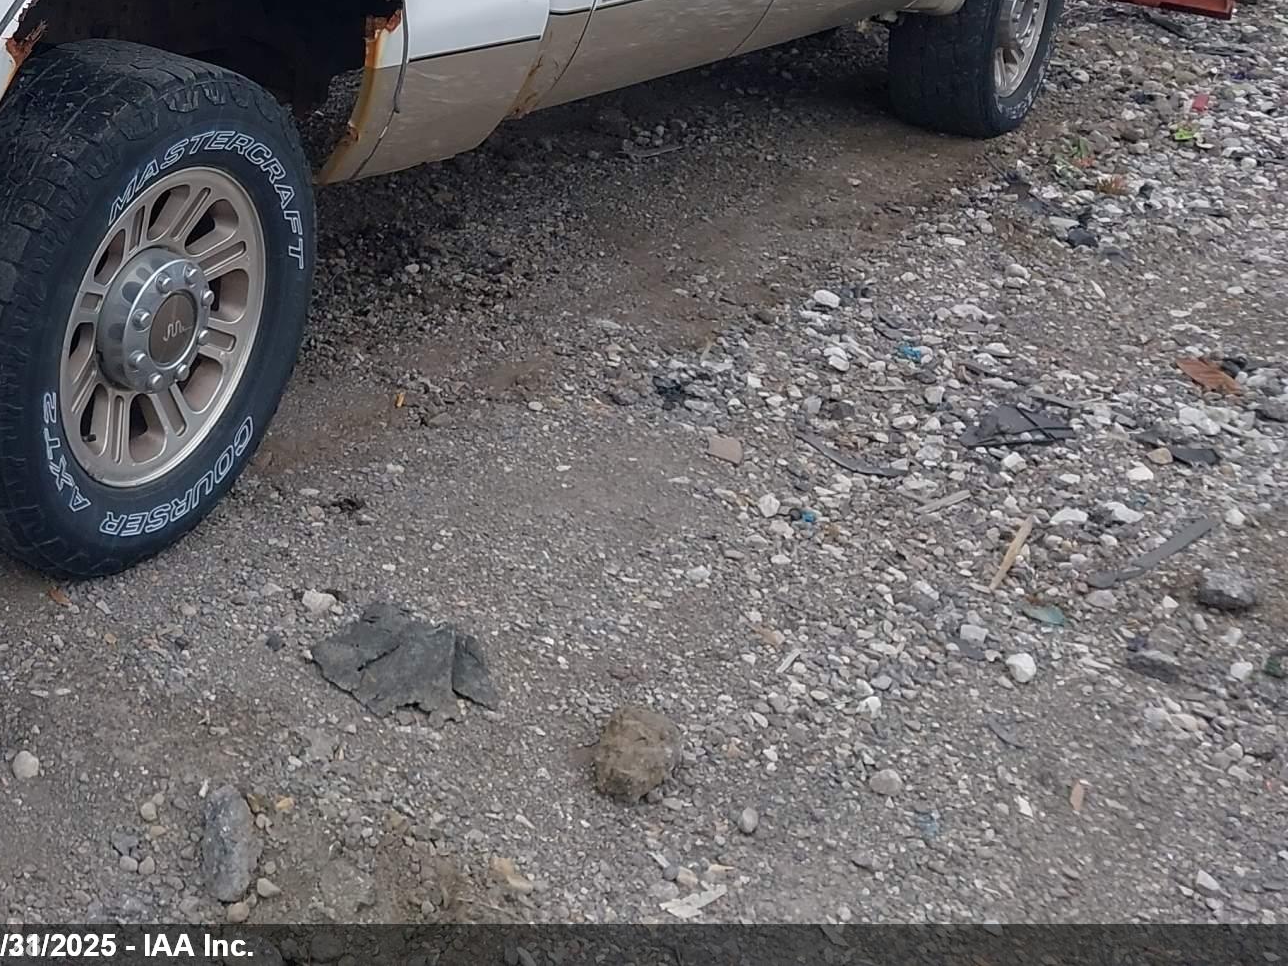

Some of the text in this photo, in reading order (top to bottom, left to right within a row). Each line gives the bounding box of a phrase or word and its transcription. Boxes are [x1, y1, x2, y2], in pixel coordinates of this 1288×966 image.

[108, 130, 305, 271] MASTERCRAFT
[42, 391, 254, 537] COURSER AXT2
